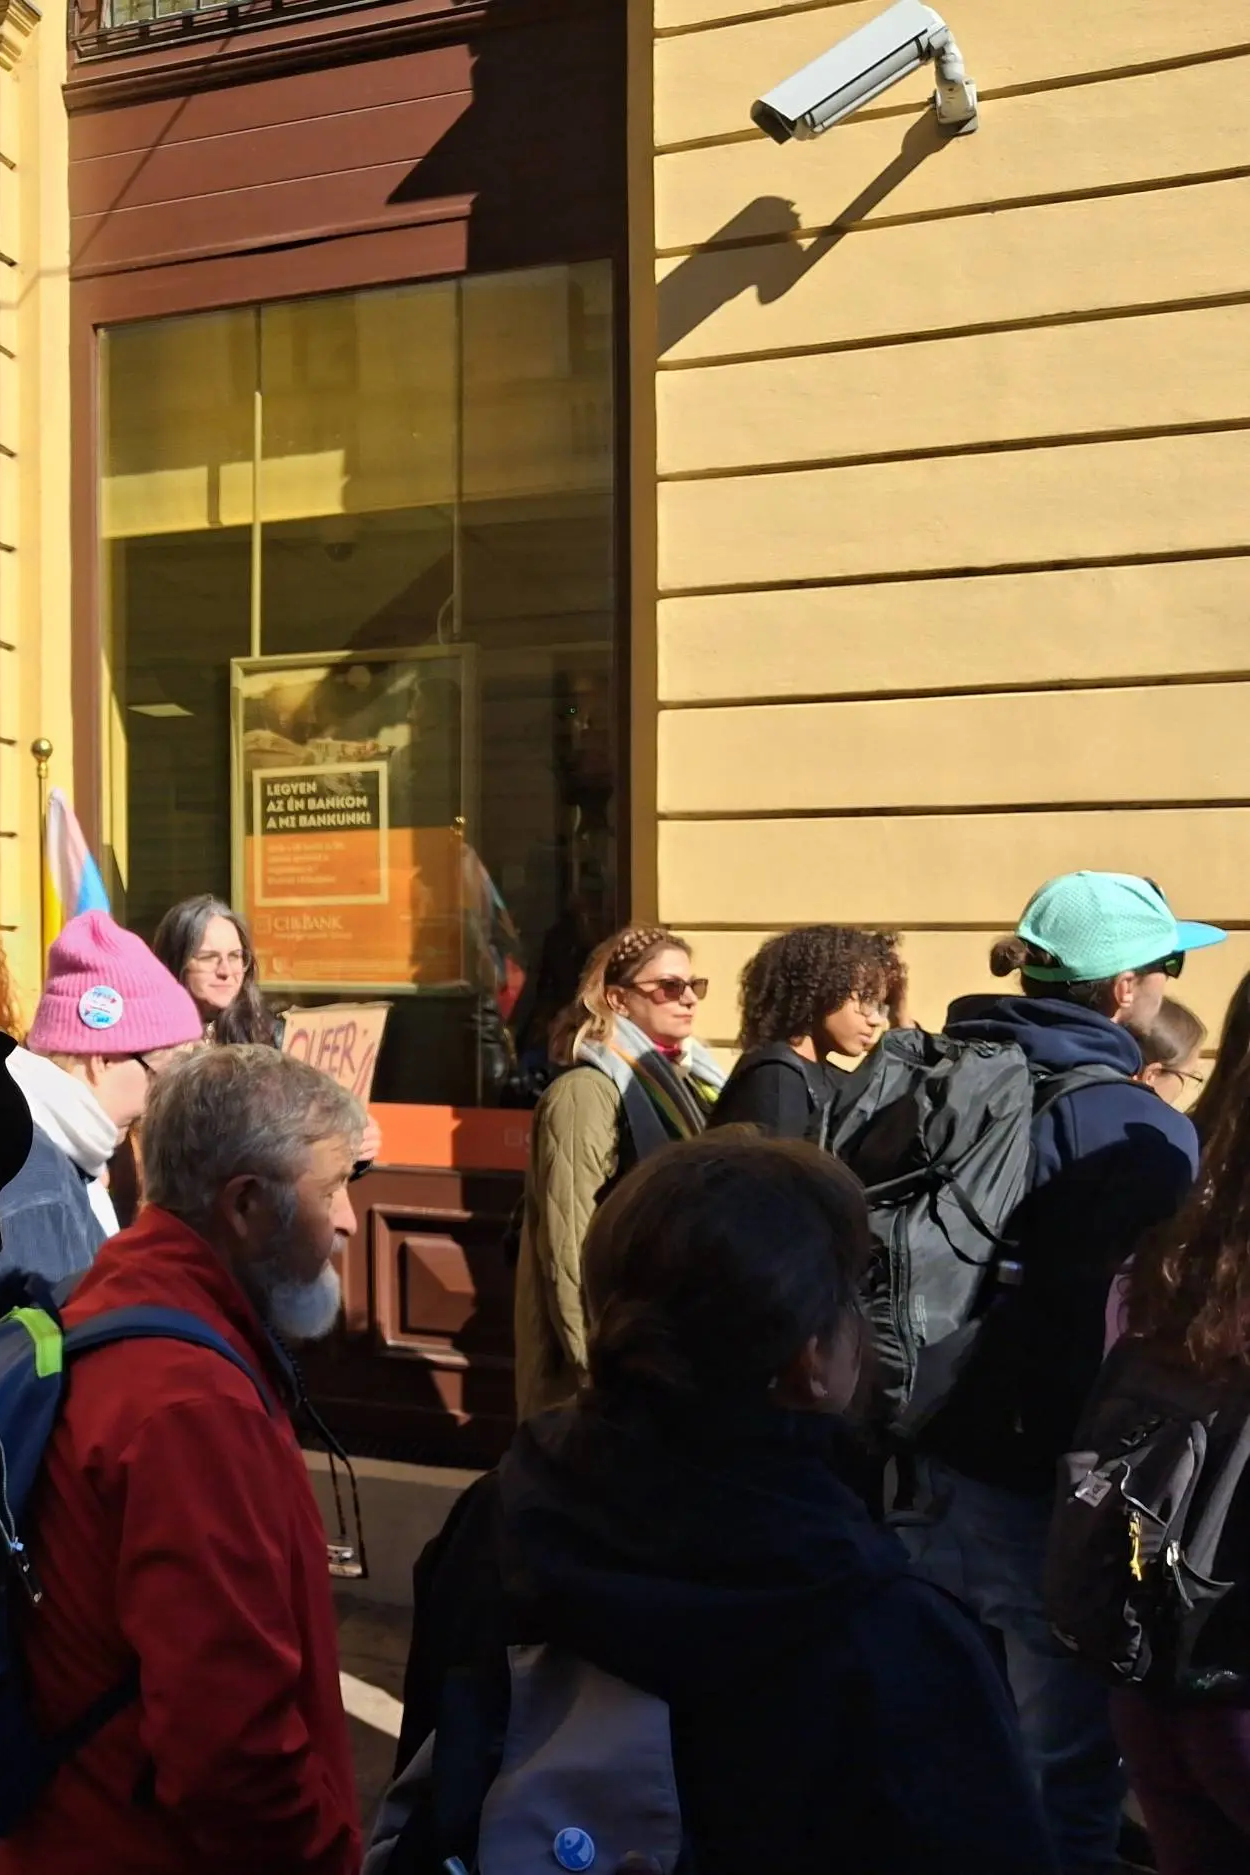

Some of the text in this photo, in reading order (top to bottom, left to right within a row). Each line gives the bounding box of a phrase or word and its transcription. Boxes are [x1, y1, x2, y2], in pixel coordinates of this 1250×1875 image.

[266, 781, 317, 796] LEGYEN
[266, 795, 369, 813] AZ ÉN BANKOM
[266, 816, 278, 830] A
[279, 814, 297, 829] MI
